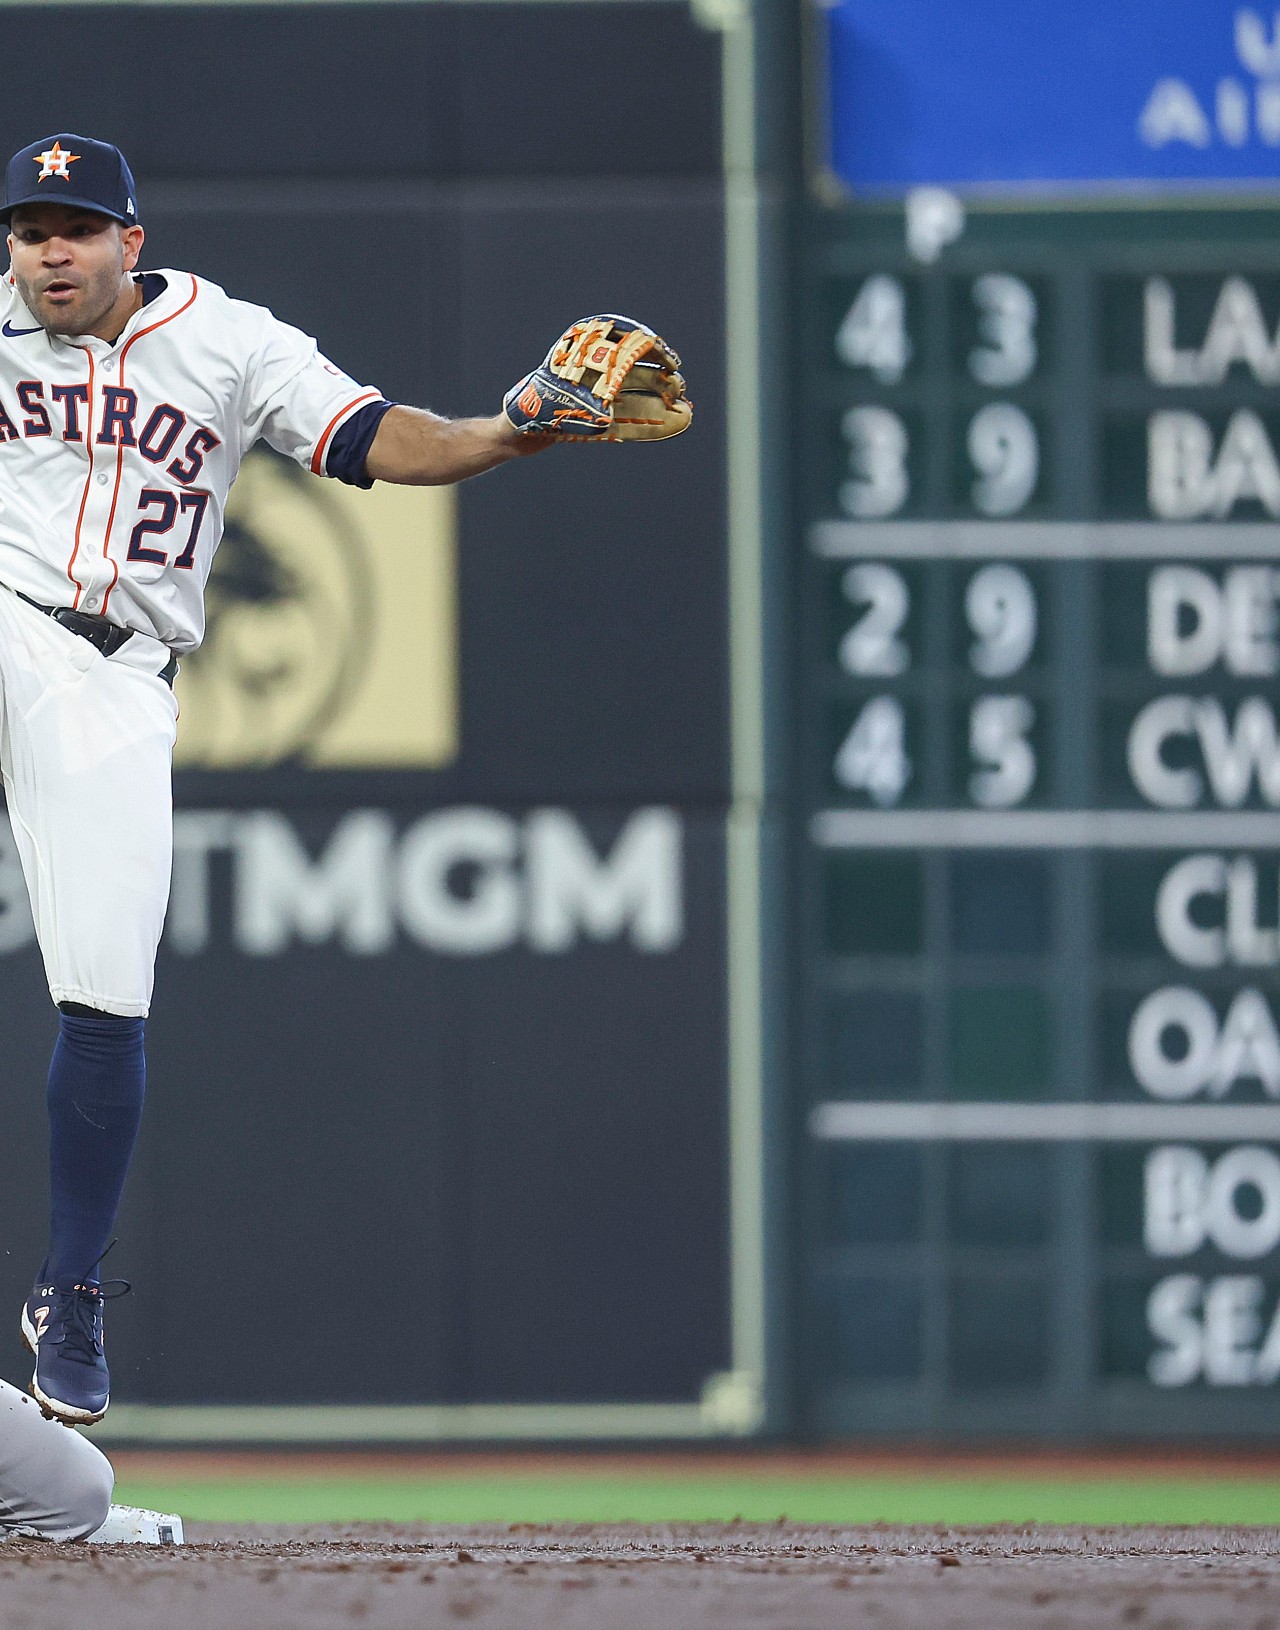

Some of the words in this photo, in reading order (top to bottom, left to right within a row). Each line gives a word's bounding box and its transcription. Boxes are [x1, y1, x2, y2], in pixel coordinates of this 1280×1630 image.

[39, 150, 72, 176] H
[905, 184, 966, 264] P
[834, 273, 912, 385] 4
[968, 272, 1038, 387] 3
[1143, 274, 1280, 388] LA
[838, 405, 910, 517] 3
[967, 402, 1039, 516] 9
[126, 488, 211, 570] 27
[839, 562, 911, 678] 2
[965, 563, 1037, 679] 9
[833, 696, 911, 808] 4
[967, 696, 1037, 808] 5
